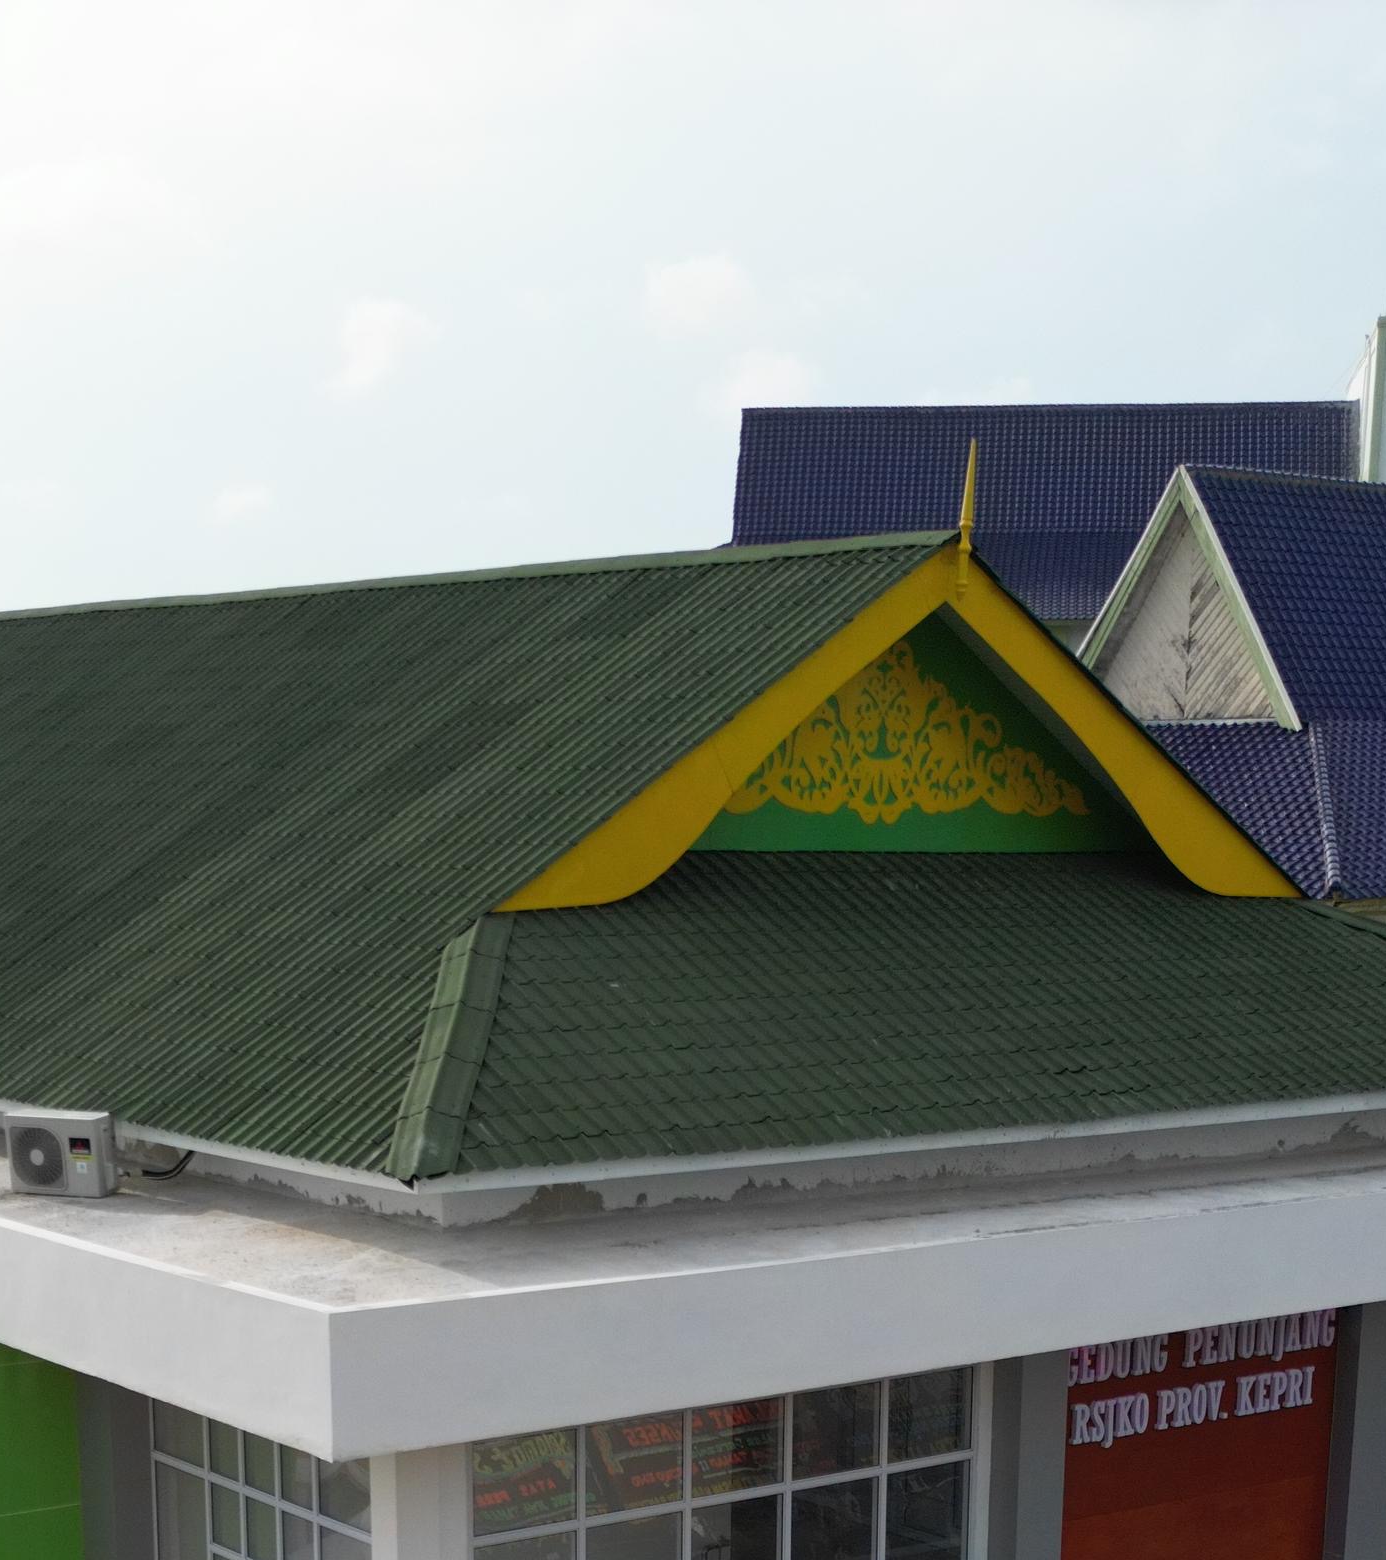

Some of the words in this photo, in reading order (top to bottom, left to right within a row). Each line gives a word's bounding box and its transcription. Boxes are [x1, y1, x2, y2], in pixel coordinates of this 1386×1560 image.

[1067, 1333, 1169, 1388] GEDUNG
[1181, 1308, 1337, 1368] PENUNJANG
[1069, 1392, 1150, 1448] RSJKO
[1154, 1380, 1228, 1430] PROV.
[1234, 1366, 1315, 1418] KEPRI
